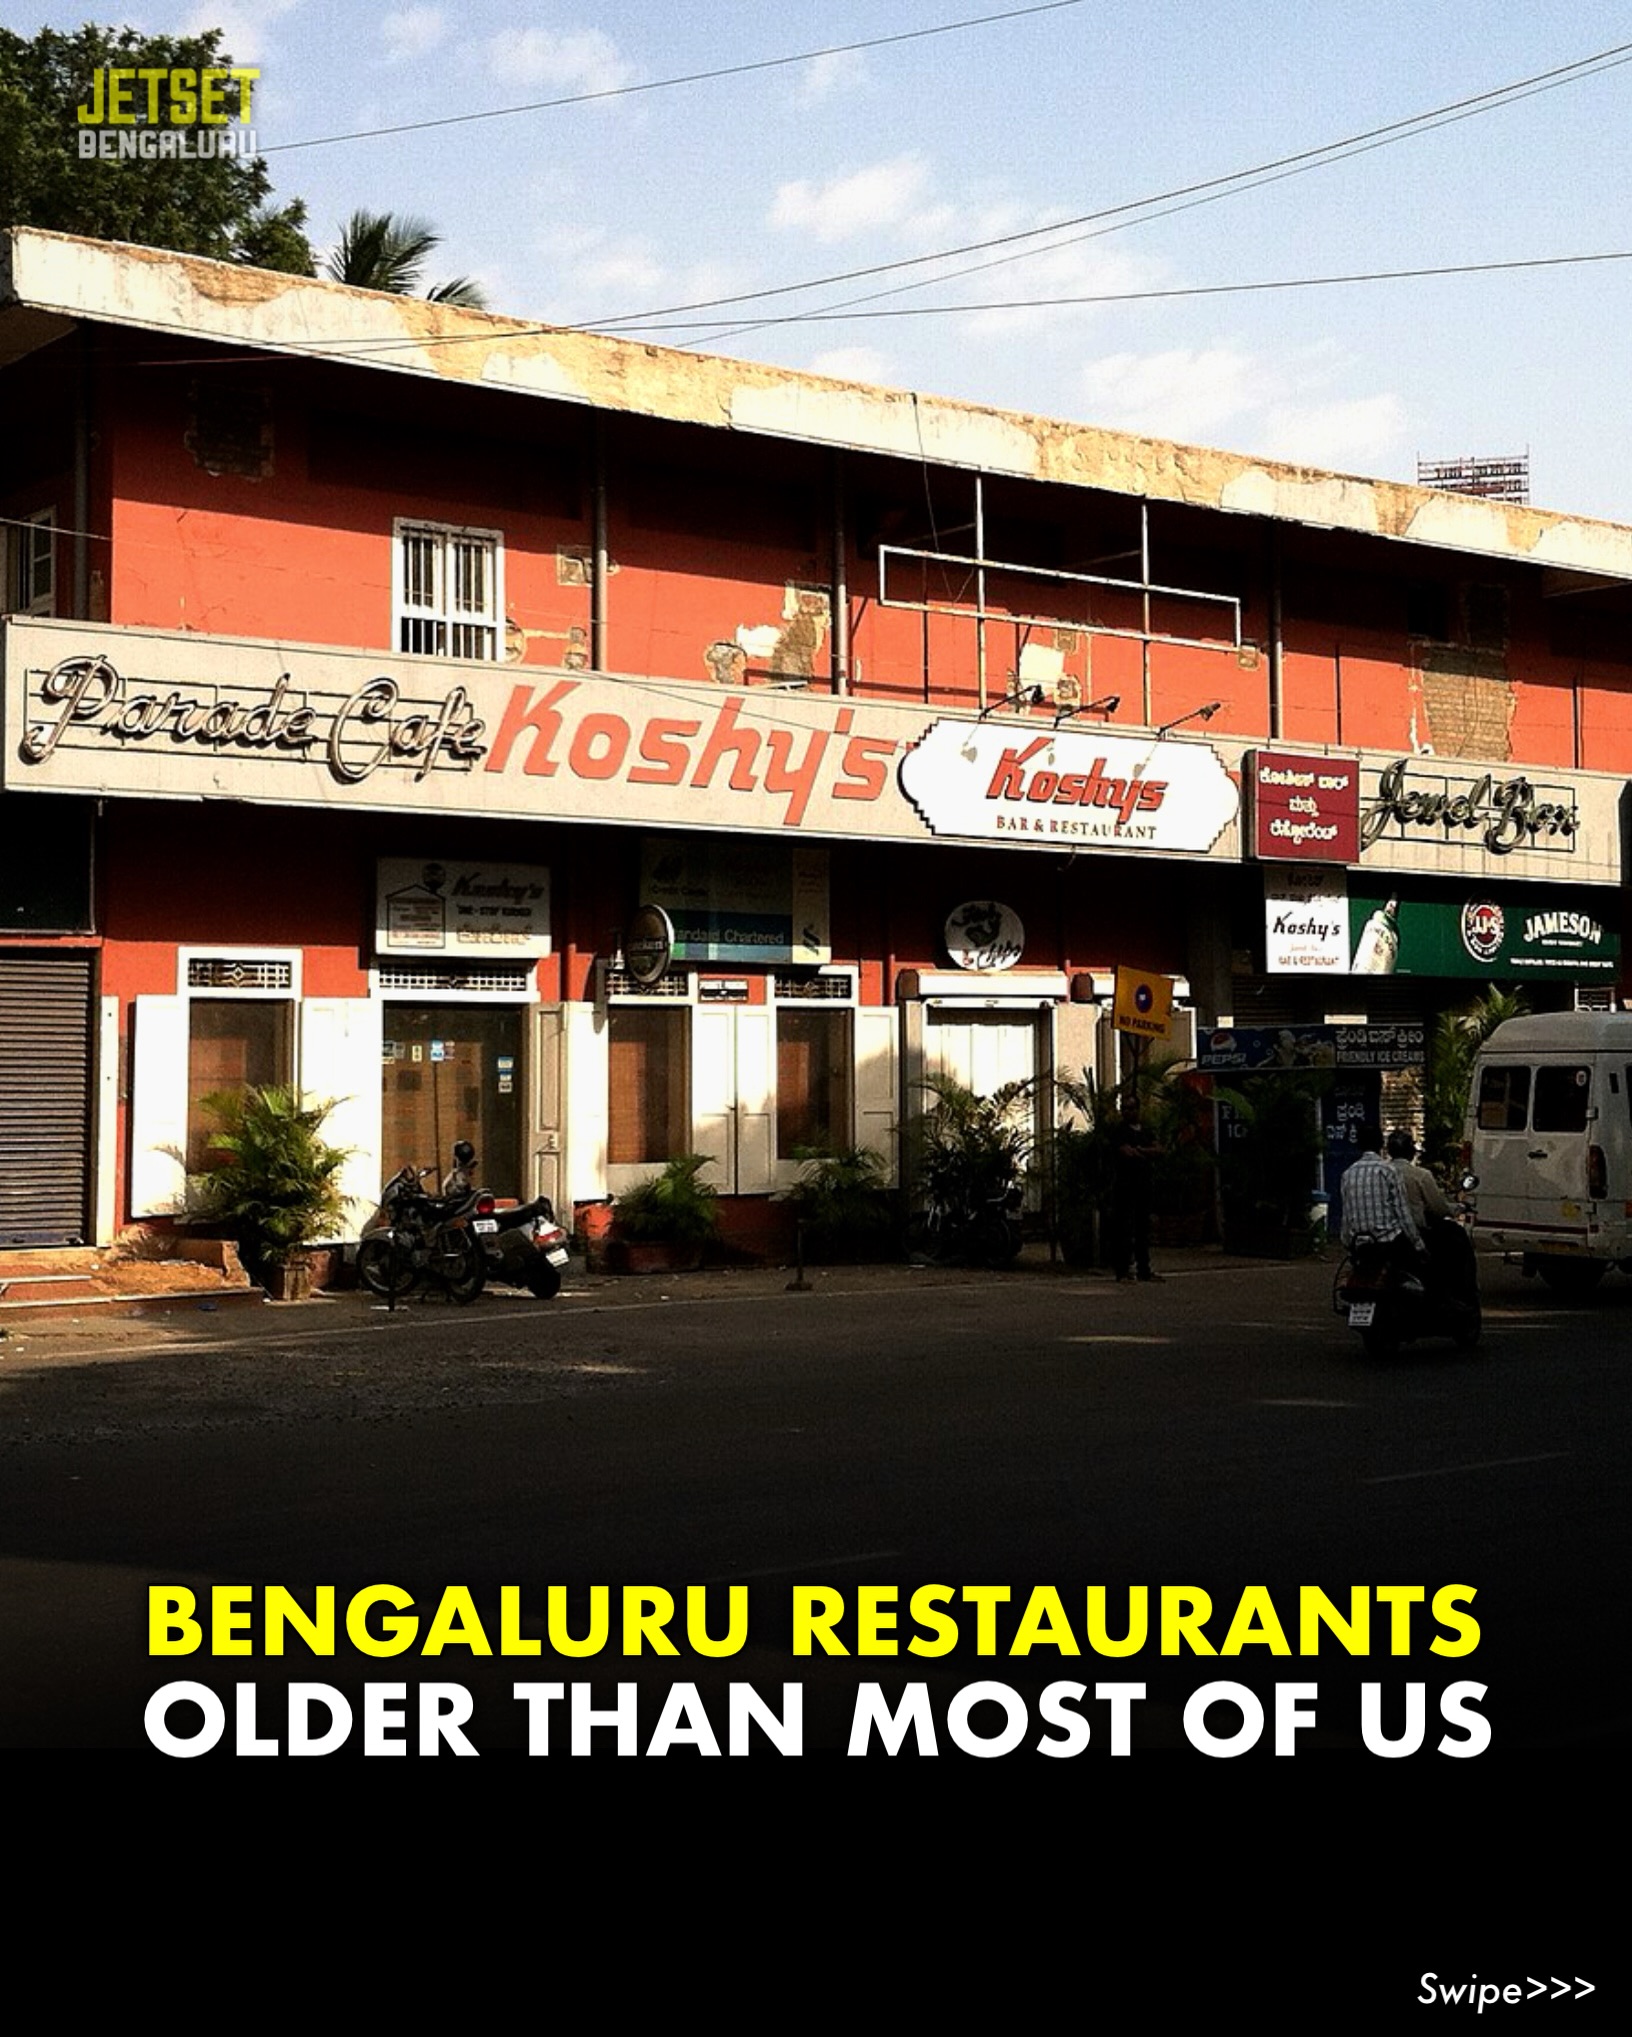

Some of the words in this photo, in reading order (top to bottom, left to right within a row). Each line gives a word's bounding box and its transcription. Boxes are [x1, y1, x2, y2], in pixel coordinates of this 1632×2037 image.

[18, 654, 319, 766] Parade
[329, 677, 486, 785] Cafe
[484, 681, 899, 826] Koshy's
[997, 815, 1031, 832] BAR
[1034, 819, 1044, 832] &
[1050, 820, 1157, 840] RESTAURANT
[675, 927, 720, 943] andard
[724, 928, 785, 945] Chartered
[1522, 911, 1602, 945] JAMESON
[1201, 1052, 1247, 1066] PEPSI
